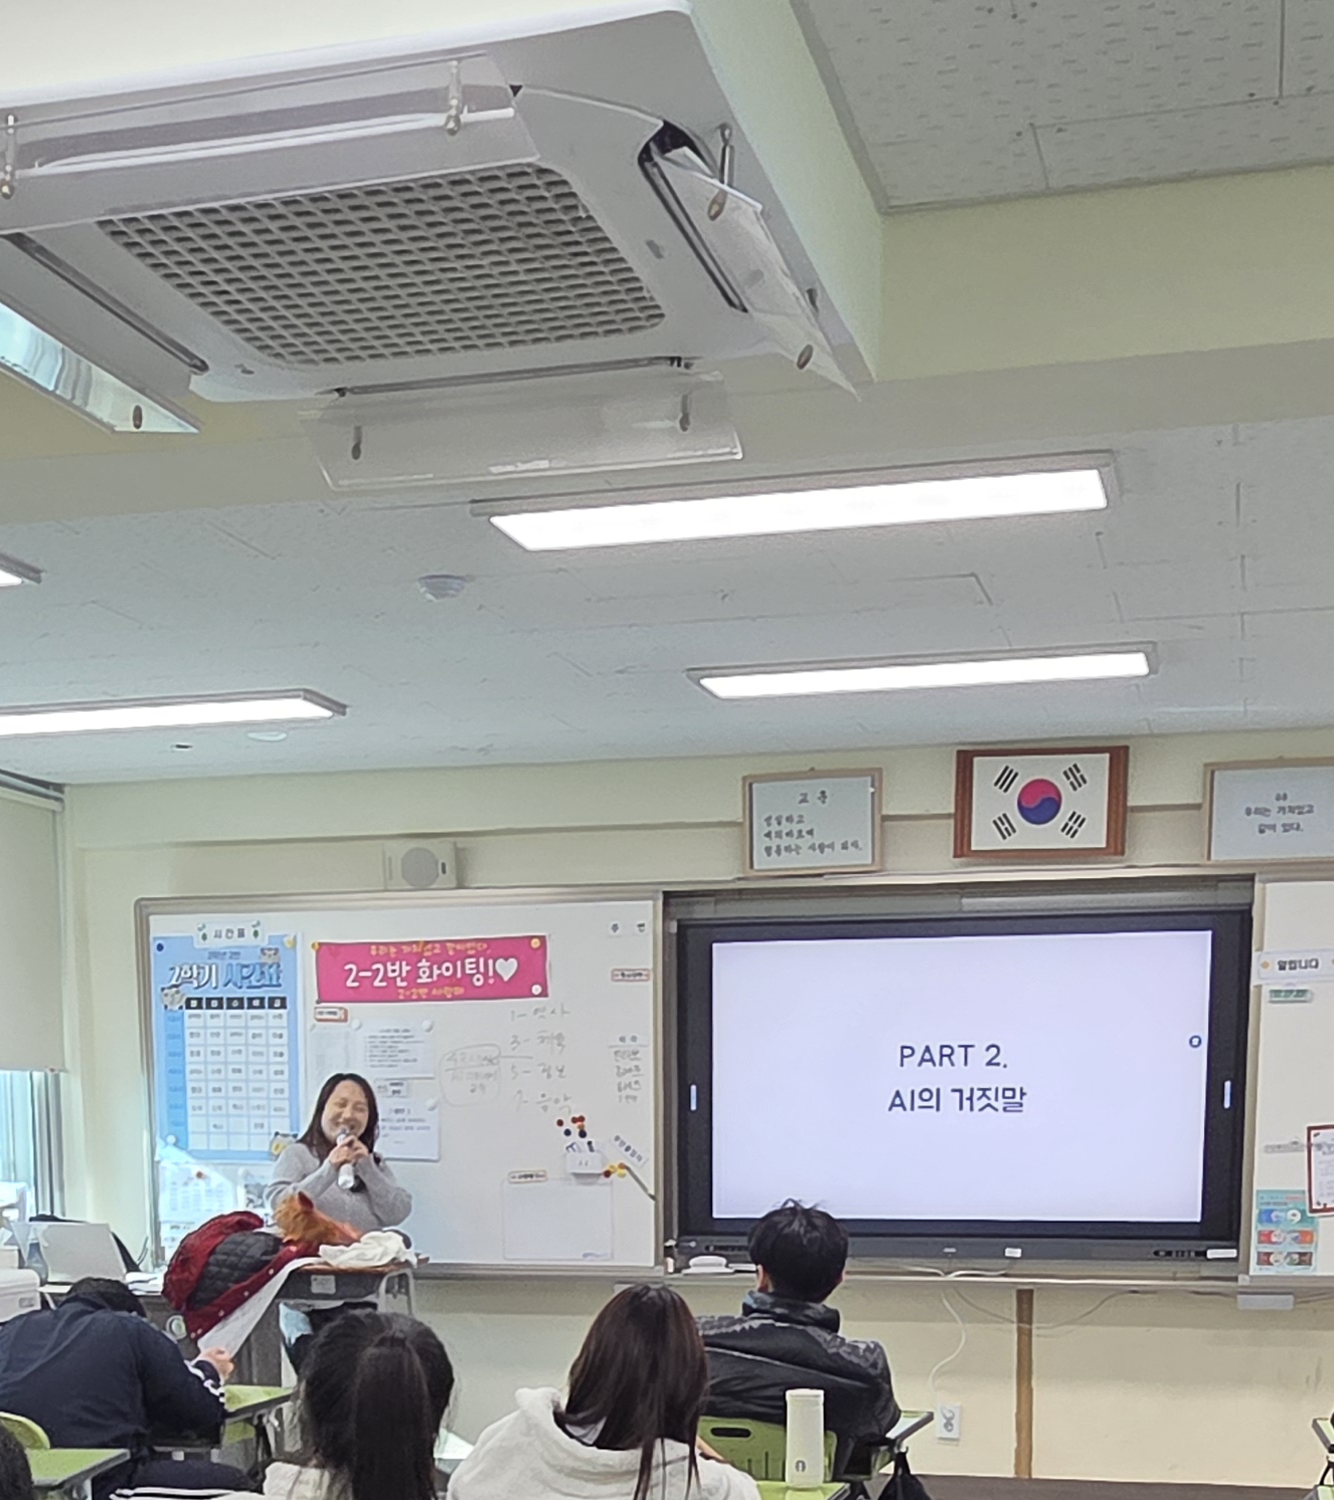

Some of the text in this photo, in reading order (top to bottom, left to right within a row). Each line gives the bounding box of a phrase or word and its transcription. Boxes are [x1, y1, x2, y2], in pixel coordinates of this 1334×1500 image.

[343, 956, 495, 988] 2-2반 화이팅!
[899, 1043, 1008, 1069] PART 2.
[887, 1085, 1028, 1113] AI의 거짓말
